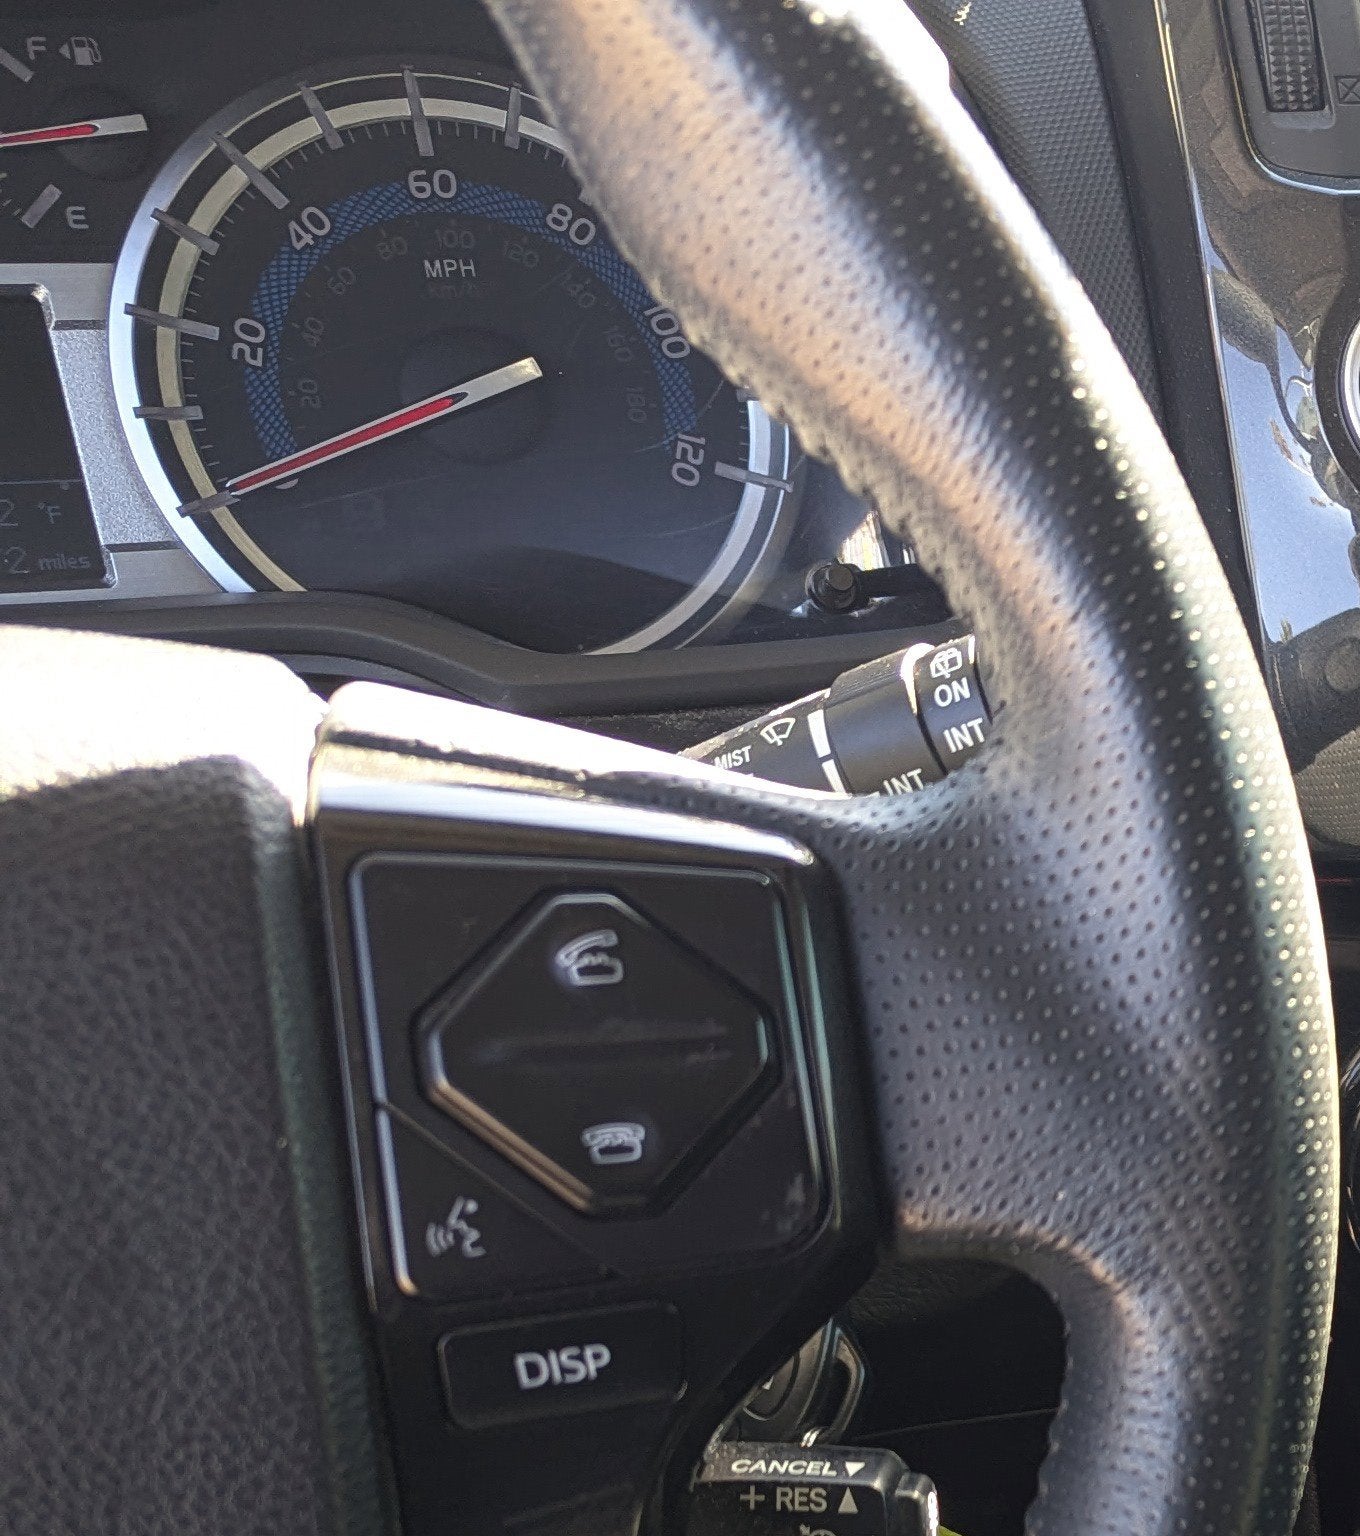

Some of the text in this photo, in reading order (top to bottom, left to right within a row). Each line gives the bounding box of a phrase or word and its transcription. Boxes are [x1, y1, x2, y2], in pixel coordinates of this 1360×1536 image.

[25, 37, 47, 61] F
[408, 169, 457, 199] 60
[66, 206, 89, 229] E
[287, 207, 330, 251] 40
[546, 203, 596, 245] 80
[423, 259, 477, 280] MPH
[231, 317, 266, 367] 20
[643, 306, 690, 359] 100
[671, 433, 705, 487] 120
[935, 678, 970, 707] ON
[943, 717, 986, 753] INT
[714, 745, 752, 770] MIST
[883, 768, 922, 798] INT
[514, 1343, 612, 1391] DISP
[731, 1459, 838, 1477] CANCEL
[776, 1486, 828, 1513] RES
